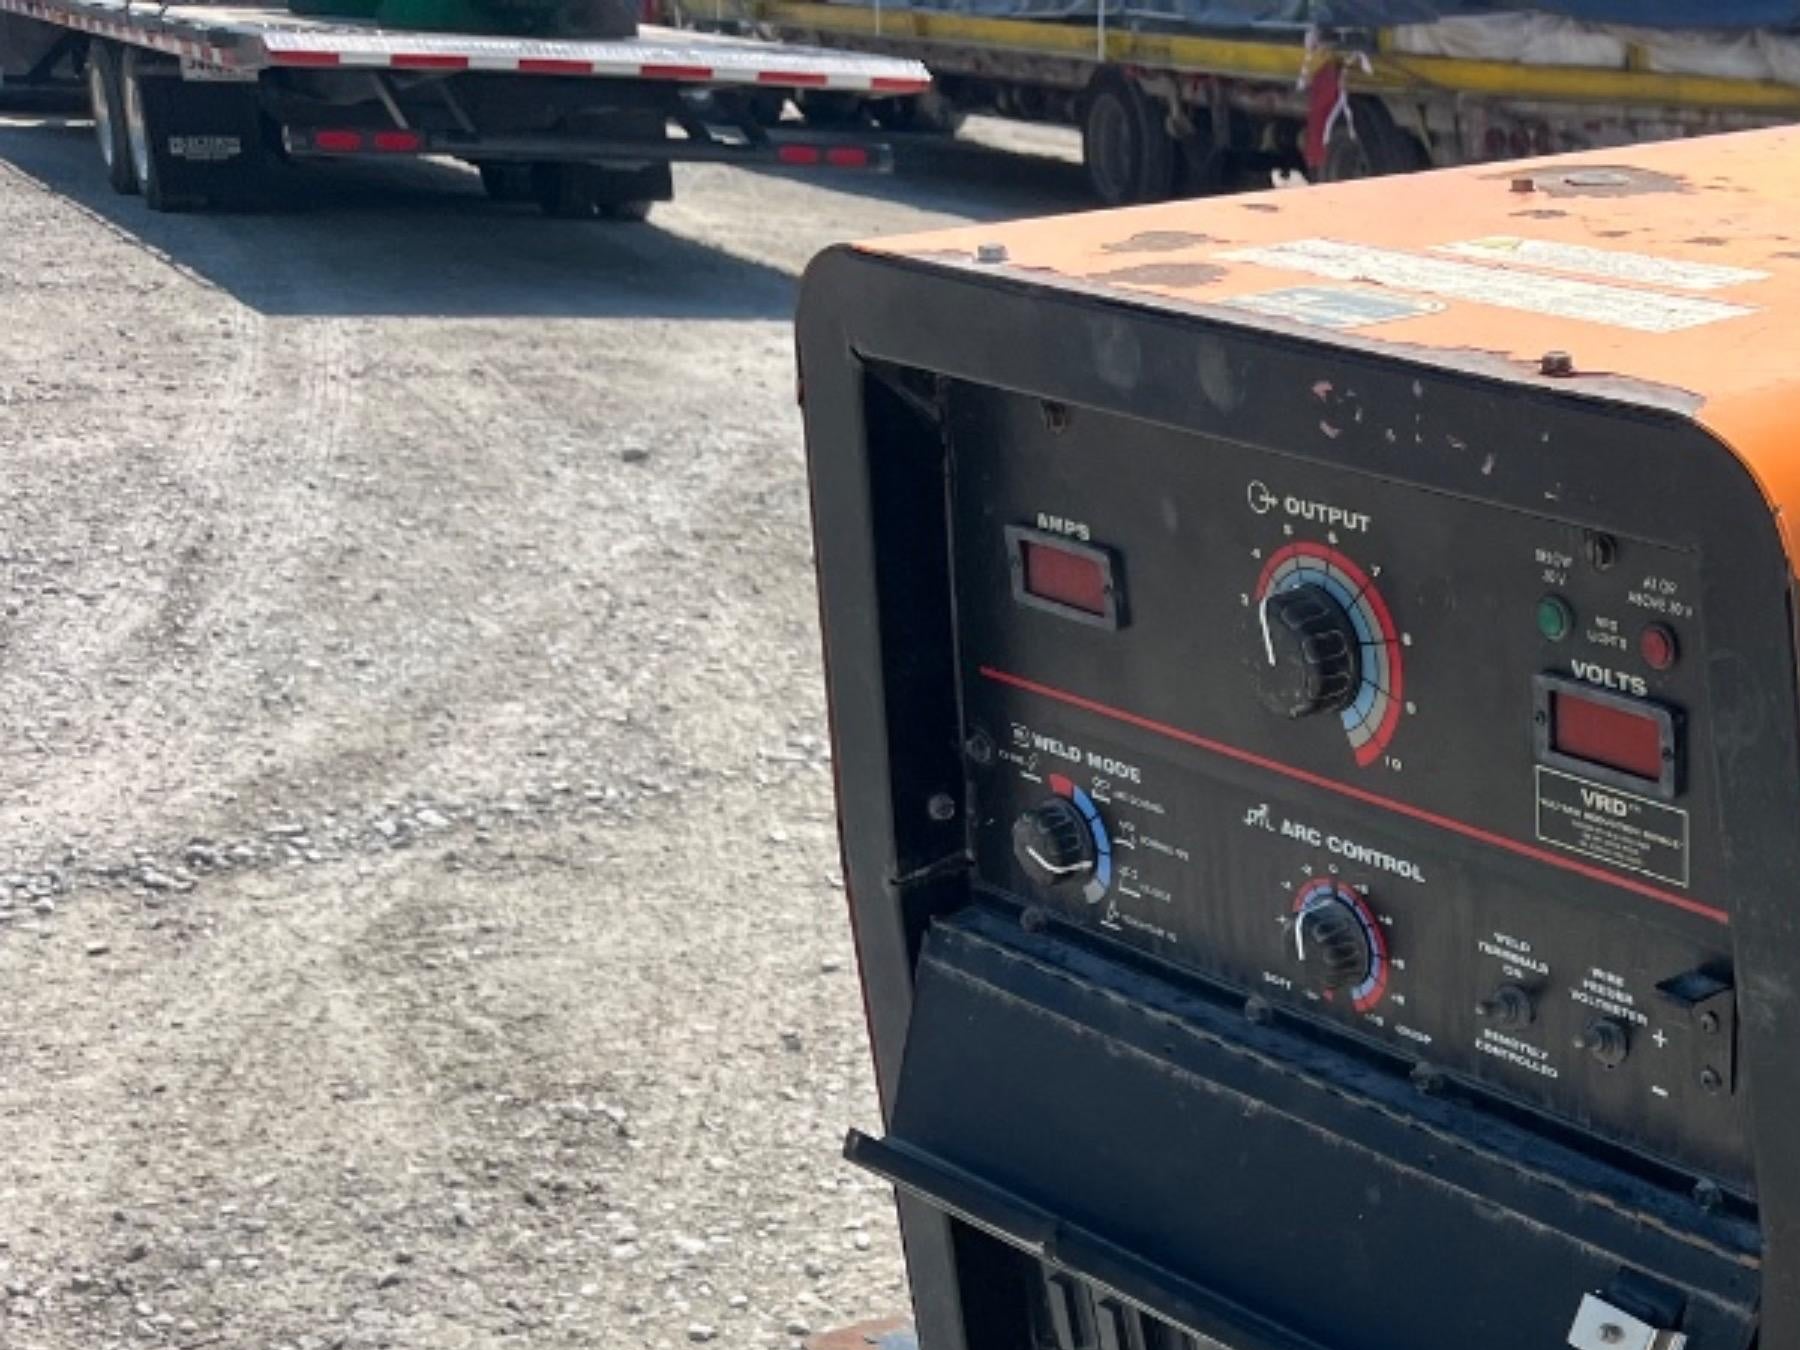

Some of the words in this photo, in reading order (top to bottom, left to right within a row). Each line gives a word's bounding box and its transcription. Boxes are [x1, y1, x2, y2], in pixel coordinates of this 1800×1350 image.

[1036, 513, 1091, 541] AMPS
[1285, 497, 1371, 532] OUTPUT
[1571, 659, 1648, 696] VOLTS
[1031, 733, 1082, 763] WELD
[1087, 752, 1142, 784] MODE
[1281, 819, 1321, 847] ARC
[1326, 836, 1425, 883] CONTROL
[1475, 1038, 1558, 1079] CONTROLLED
